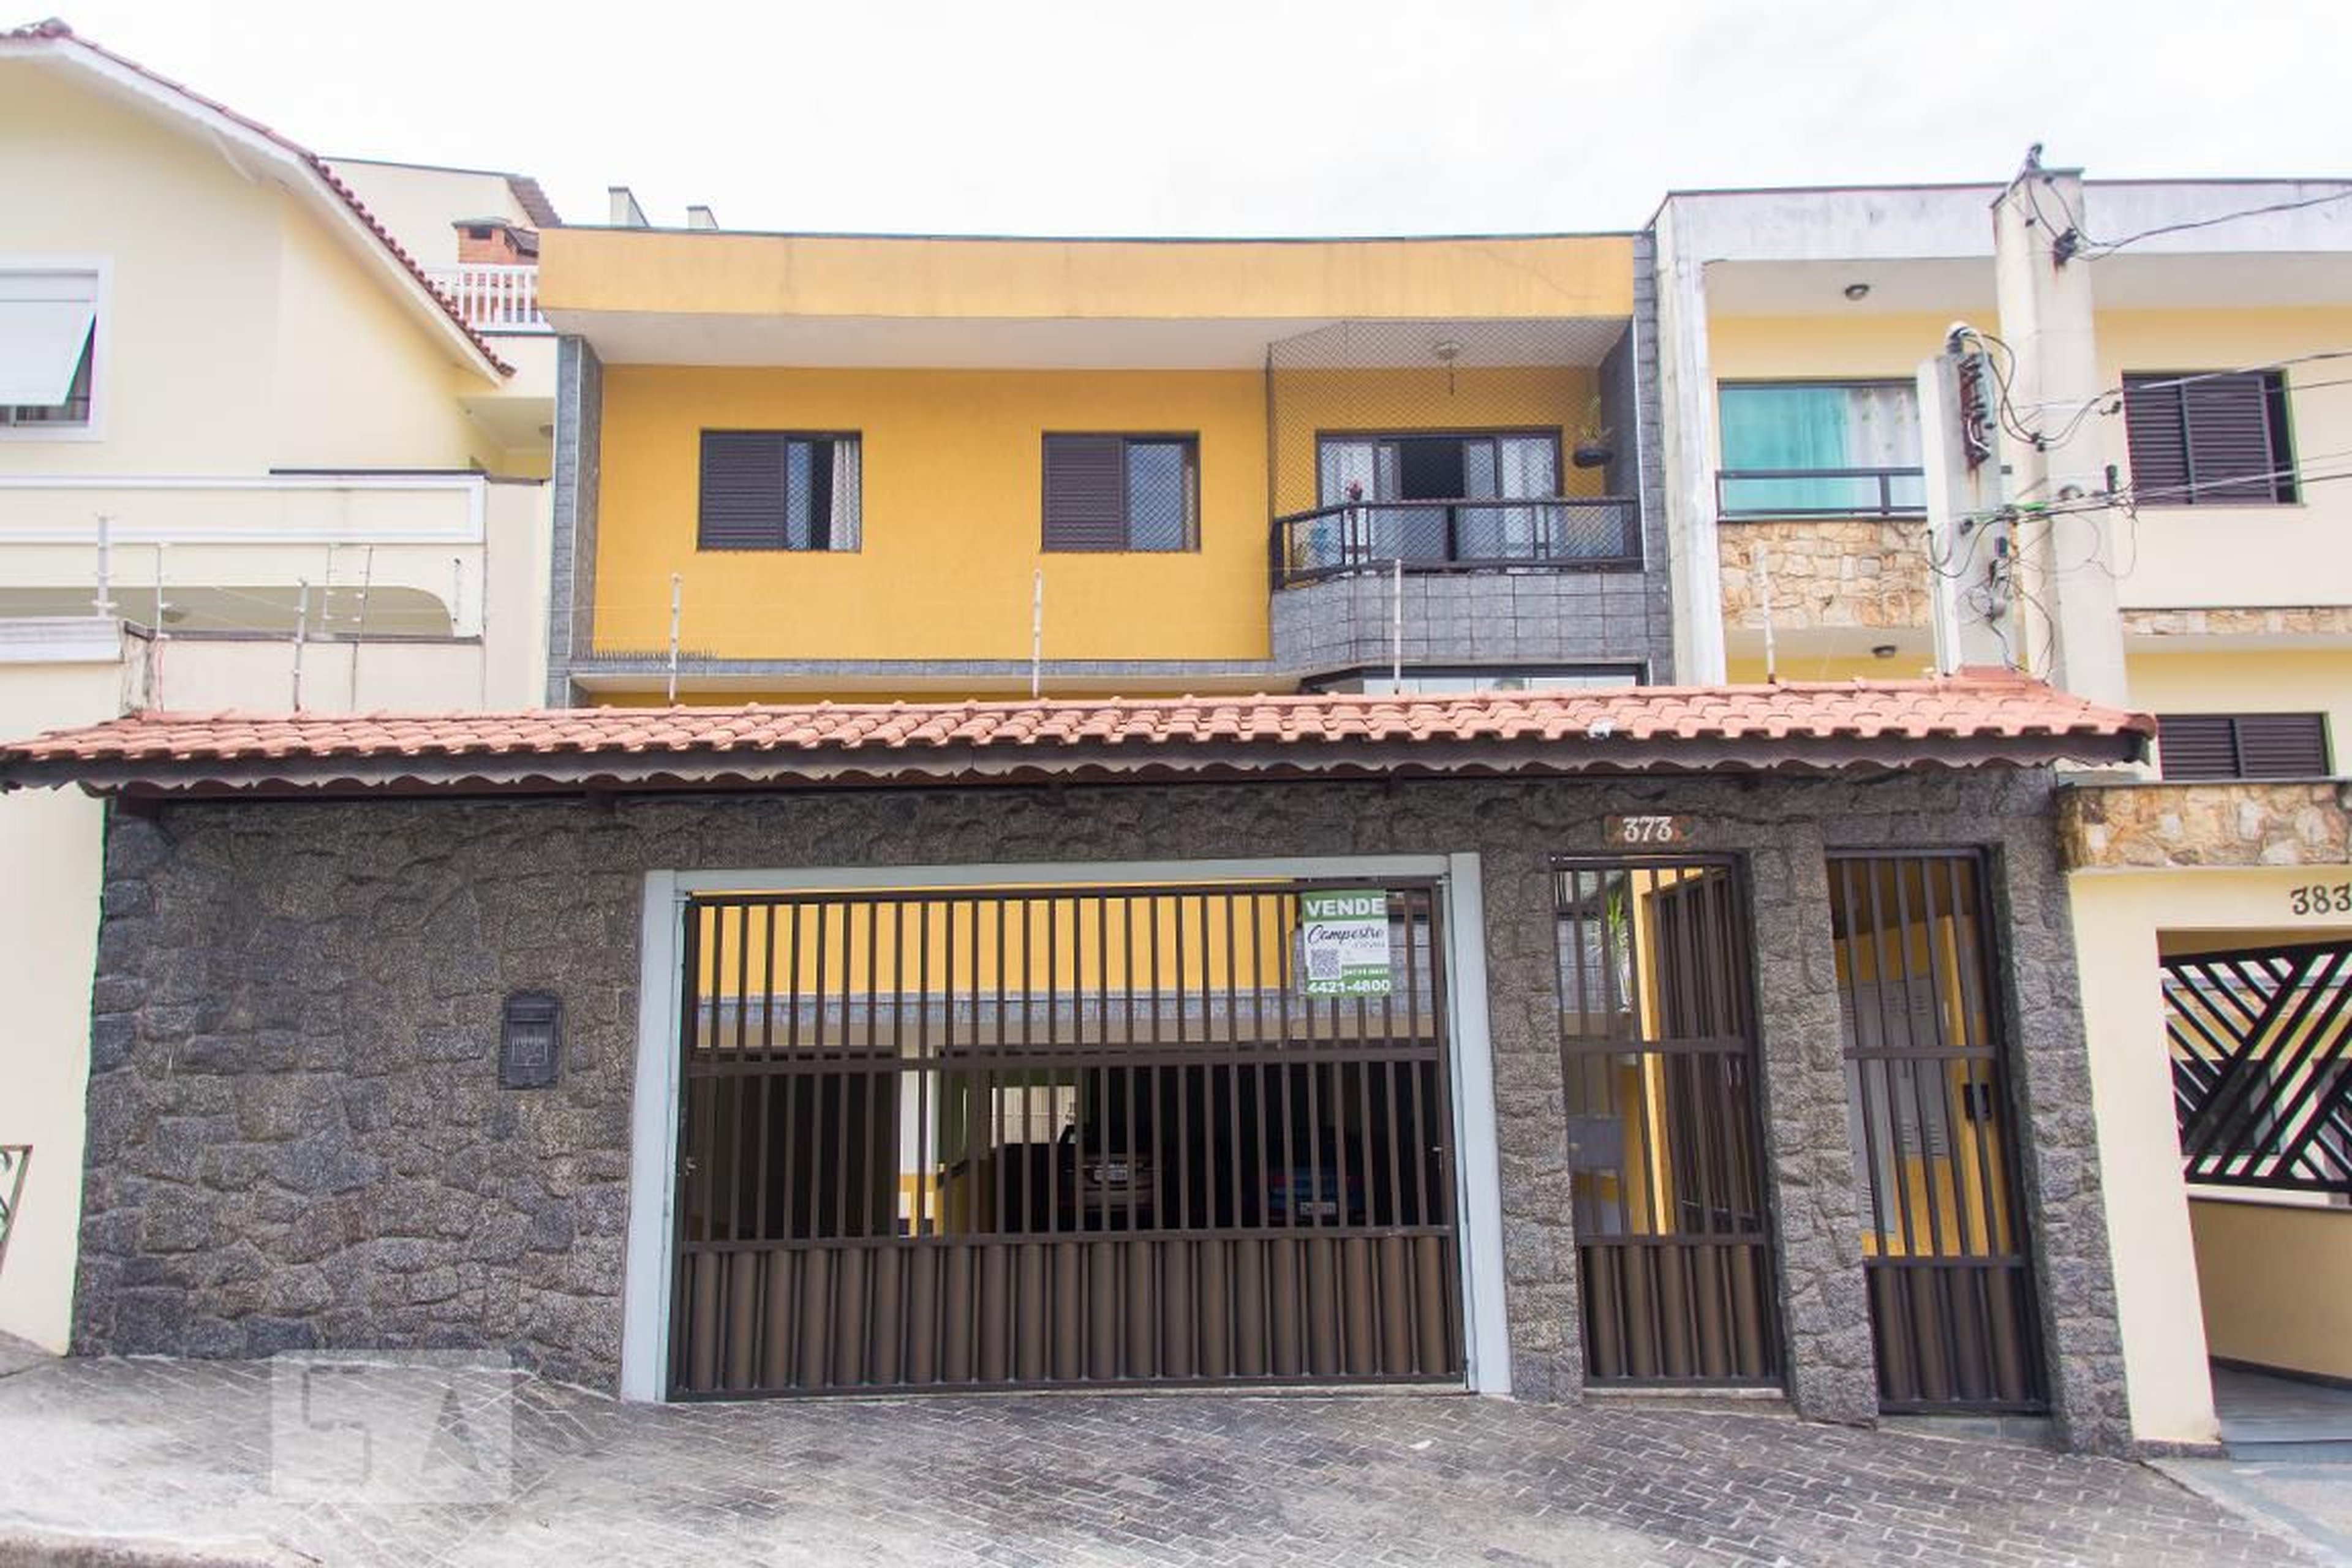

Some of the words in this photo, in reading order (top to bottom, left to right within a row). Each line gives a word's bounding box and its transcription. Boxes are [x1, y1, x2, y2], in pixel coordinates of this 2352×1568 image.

[1623, 816, 1673, 842] 373
[1305, 897, 1386, 916] VENDE
[2290, 883, 2351, 915] 383
